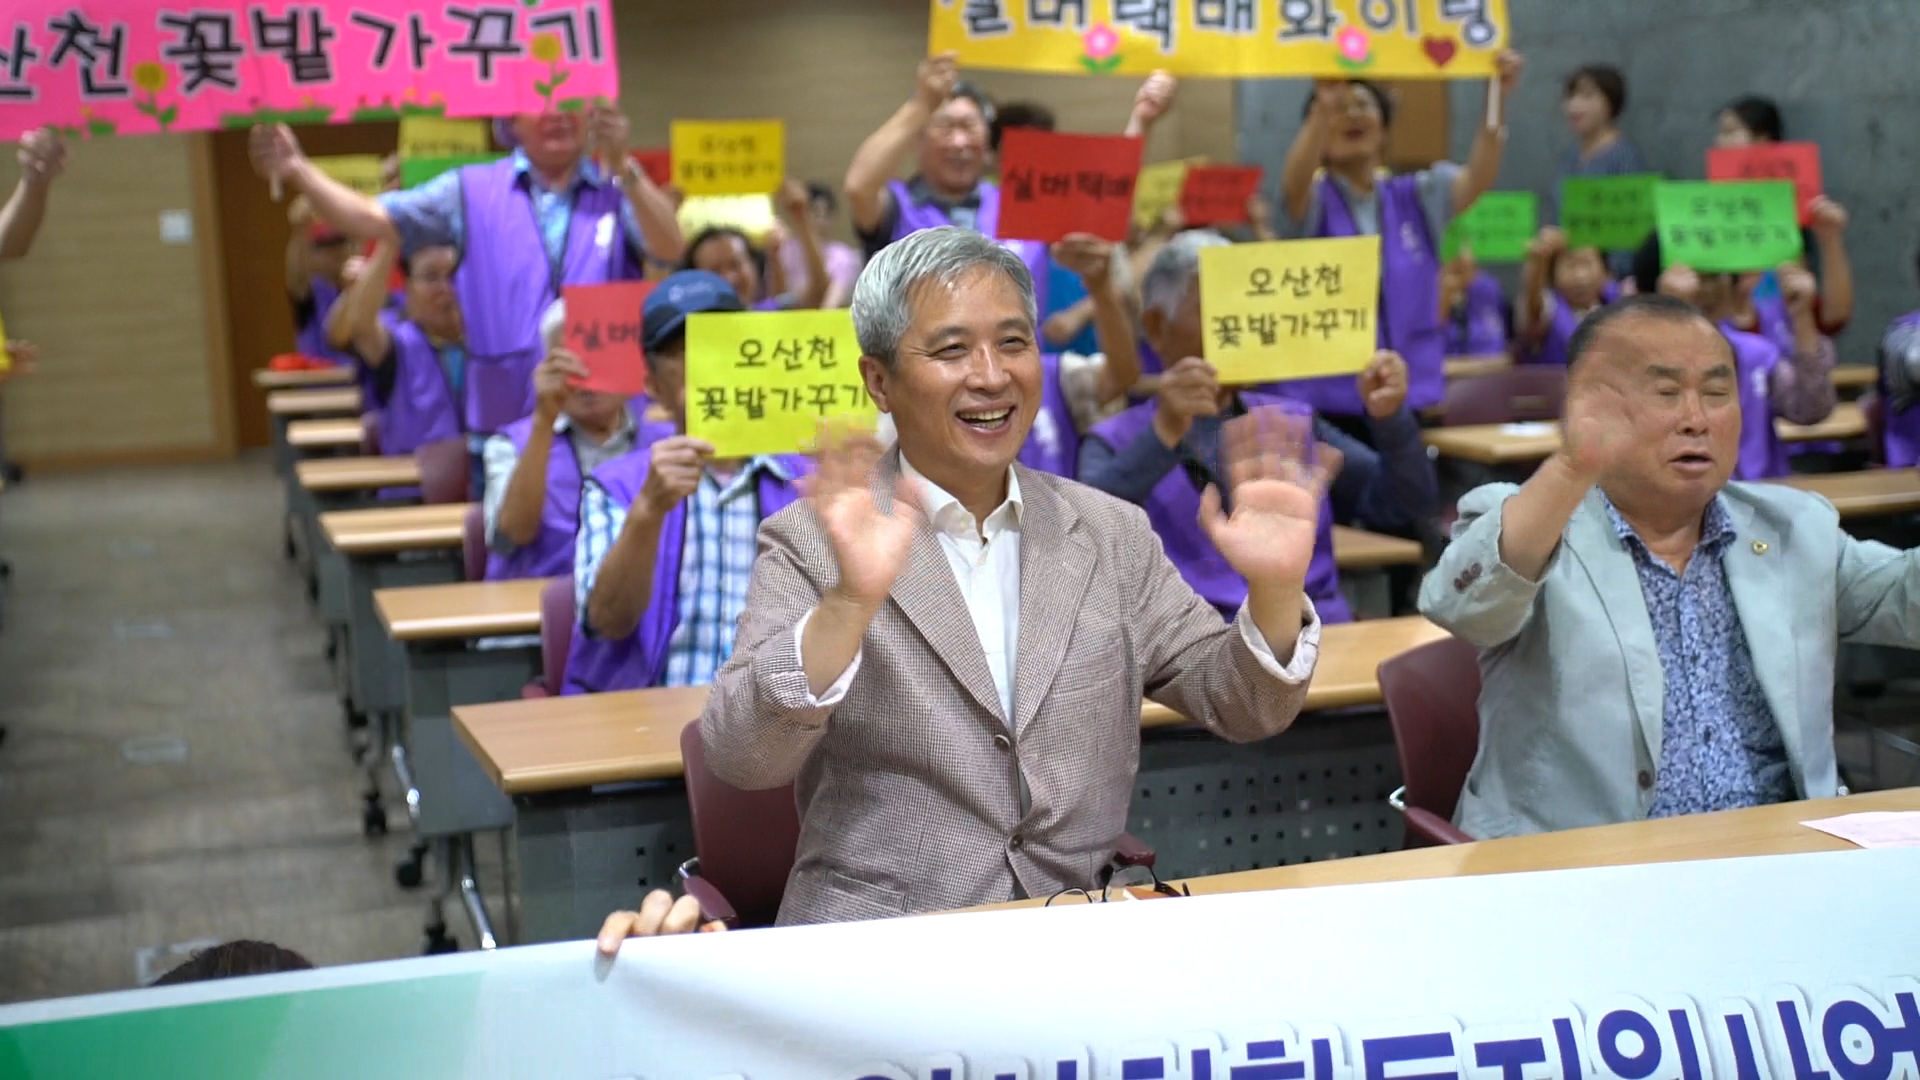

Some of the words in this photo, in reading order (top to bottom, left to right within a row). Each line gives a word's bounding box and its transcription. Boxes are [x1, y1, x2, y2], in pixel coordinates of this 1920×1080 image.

[160, 6, 604, 93] 꽃밭가꾸기
[1244, 263, 1342, 297] 오산천
[1211, 306, 1368, 349] 꽃밭가꾸기
[734, 334, 838, 372] 오산천
[696, 383, 868, 422] 꽃밭가꾸기
